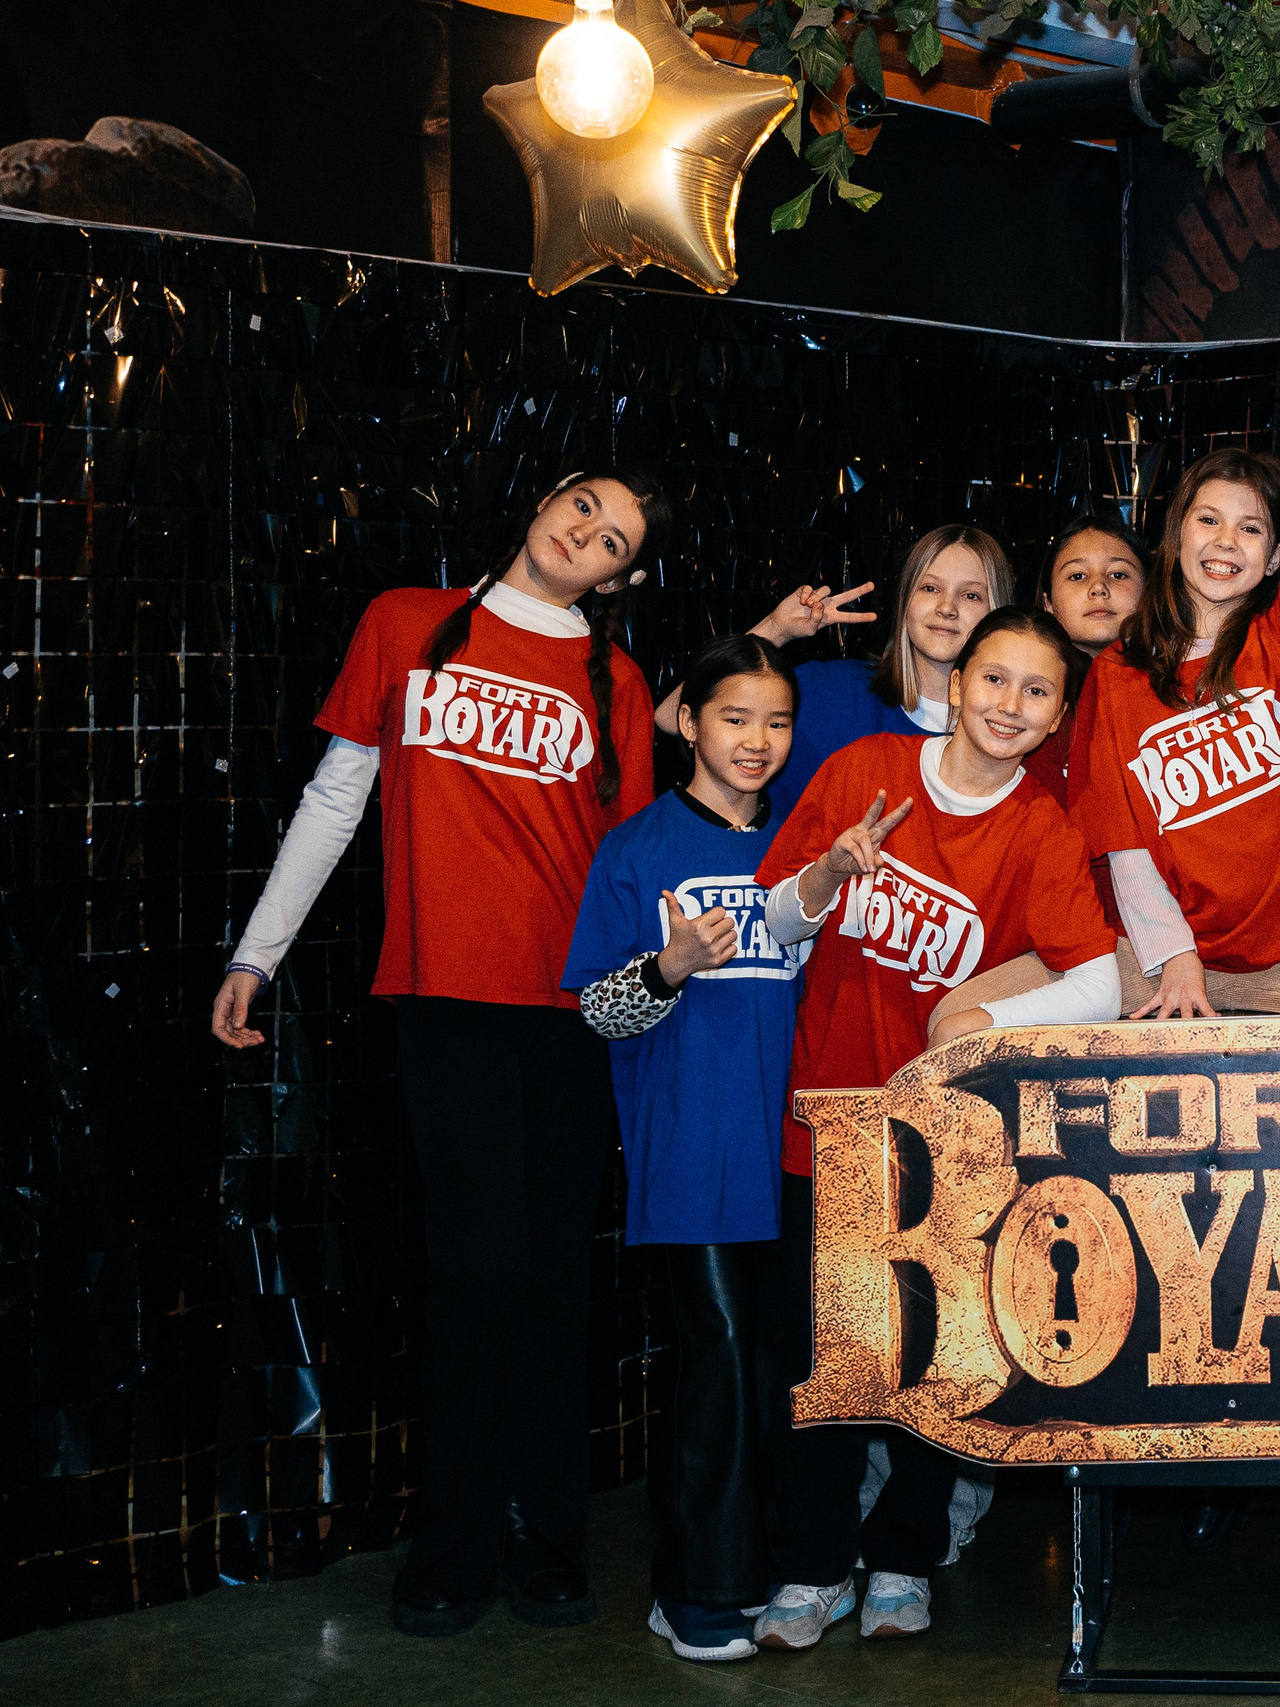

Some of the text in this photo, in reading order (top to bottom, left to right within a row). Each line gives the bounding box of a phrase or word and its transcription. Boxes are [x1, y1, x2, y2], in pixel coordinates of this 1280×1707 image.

[459, 677, 555, 711] FORT
[402, 669, 594, 782] BOYARD
[1157, 708, 1239, 757] FORT
[703, 889, 769, 907] FOR
